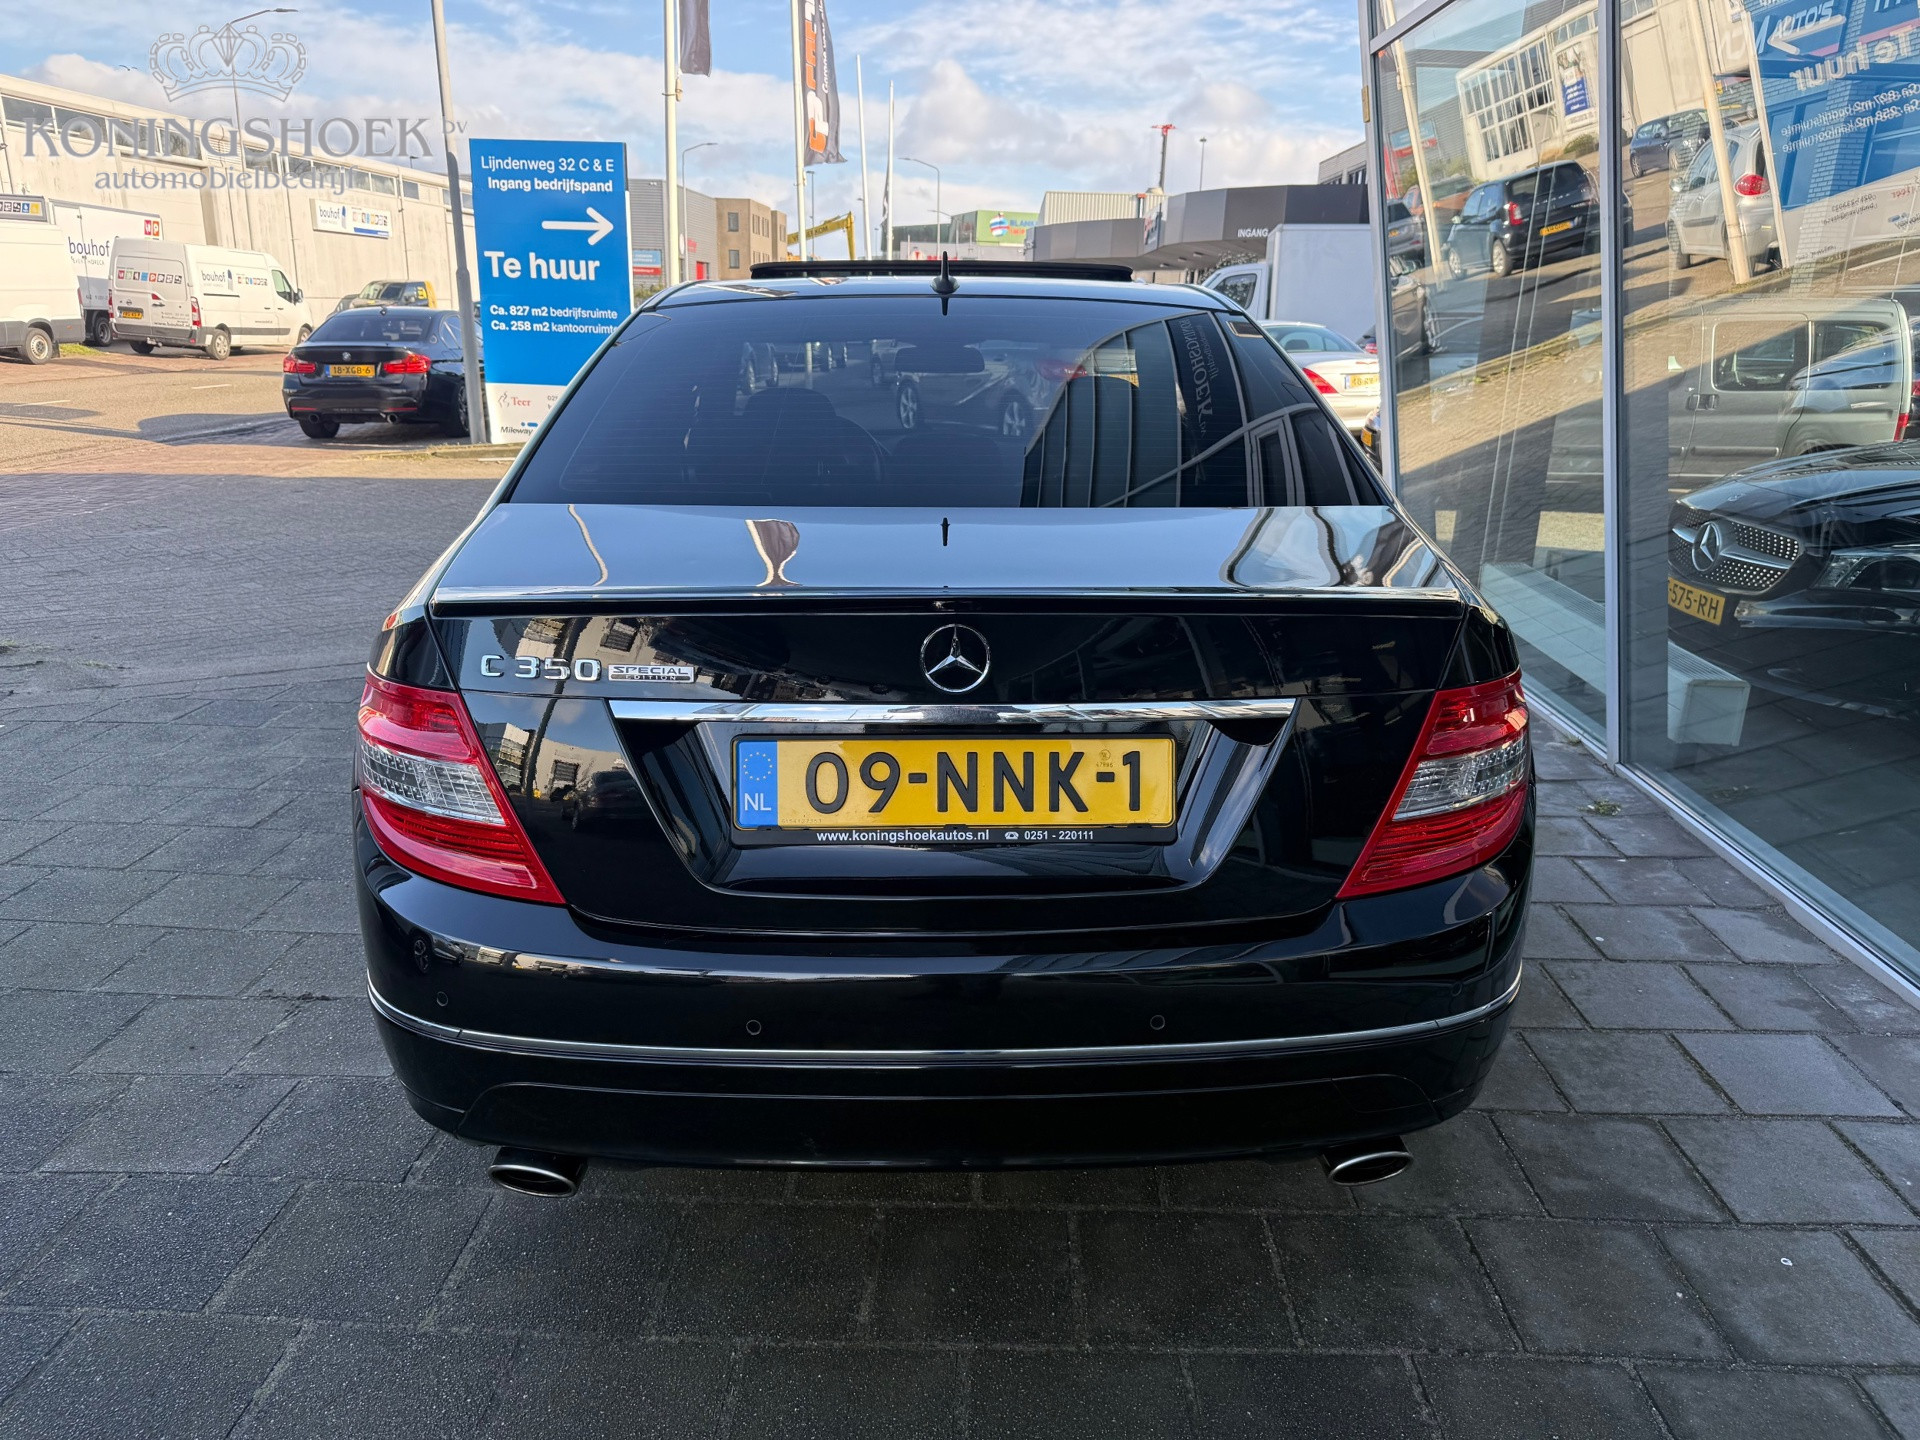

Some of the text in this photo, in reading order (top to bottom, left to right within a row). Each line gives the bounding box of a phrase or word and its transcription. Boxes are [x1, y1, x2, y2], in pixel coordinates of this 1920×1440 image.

[481, 156, 615, 173] Lijndenweg 32 C & E
[488, 177, 613, 194] Ingang bedrijfspand
[1237, 228, 1269, 238] INGANG
[68, 236, 110, 257] bouhof
[484, 251, 600, 281] Te huur
[201, 270, 226, 283] bouhof
[490, 305, 618, 320] Ca. 827 m2 bedrijfsruimte
[491, 320, 509, 331] Ca.
[510, 321, 532, 331] 258
[533, 322, 550, 332] m2
[500, 426, 534, 436] Mileway
[481, 655, 601, 681] C 350
[613, 666, 689, 675] SPECIAL
[805, 750, 1140, 814] 09-NNK-1
[744, 793, 771, 811] NL
[817, 830, 990, 844] www.koningshoekautos.nl
[1024, 830, 1048, 841] 0251
[1059, 830, 1094, 840] 220111
